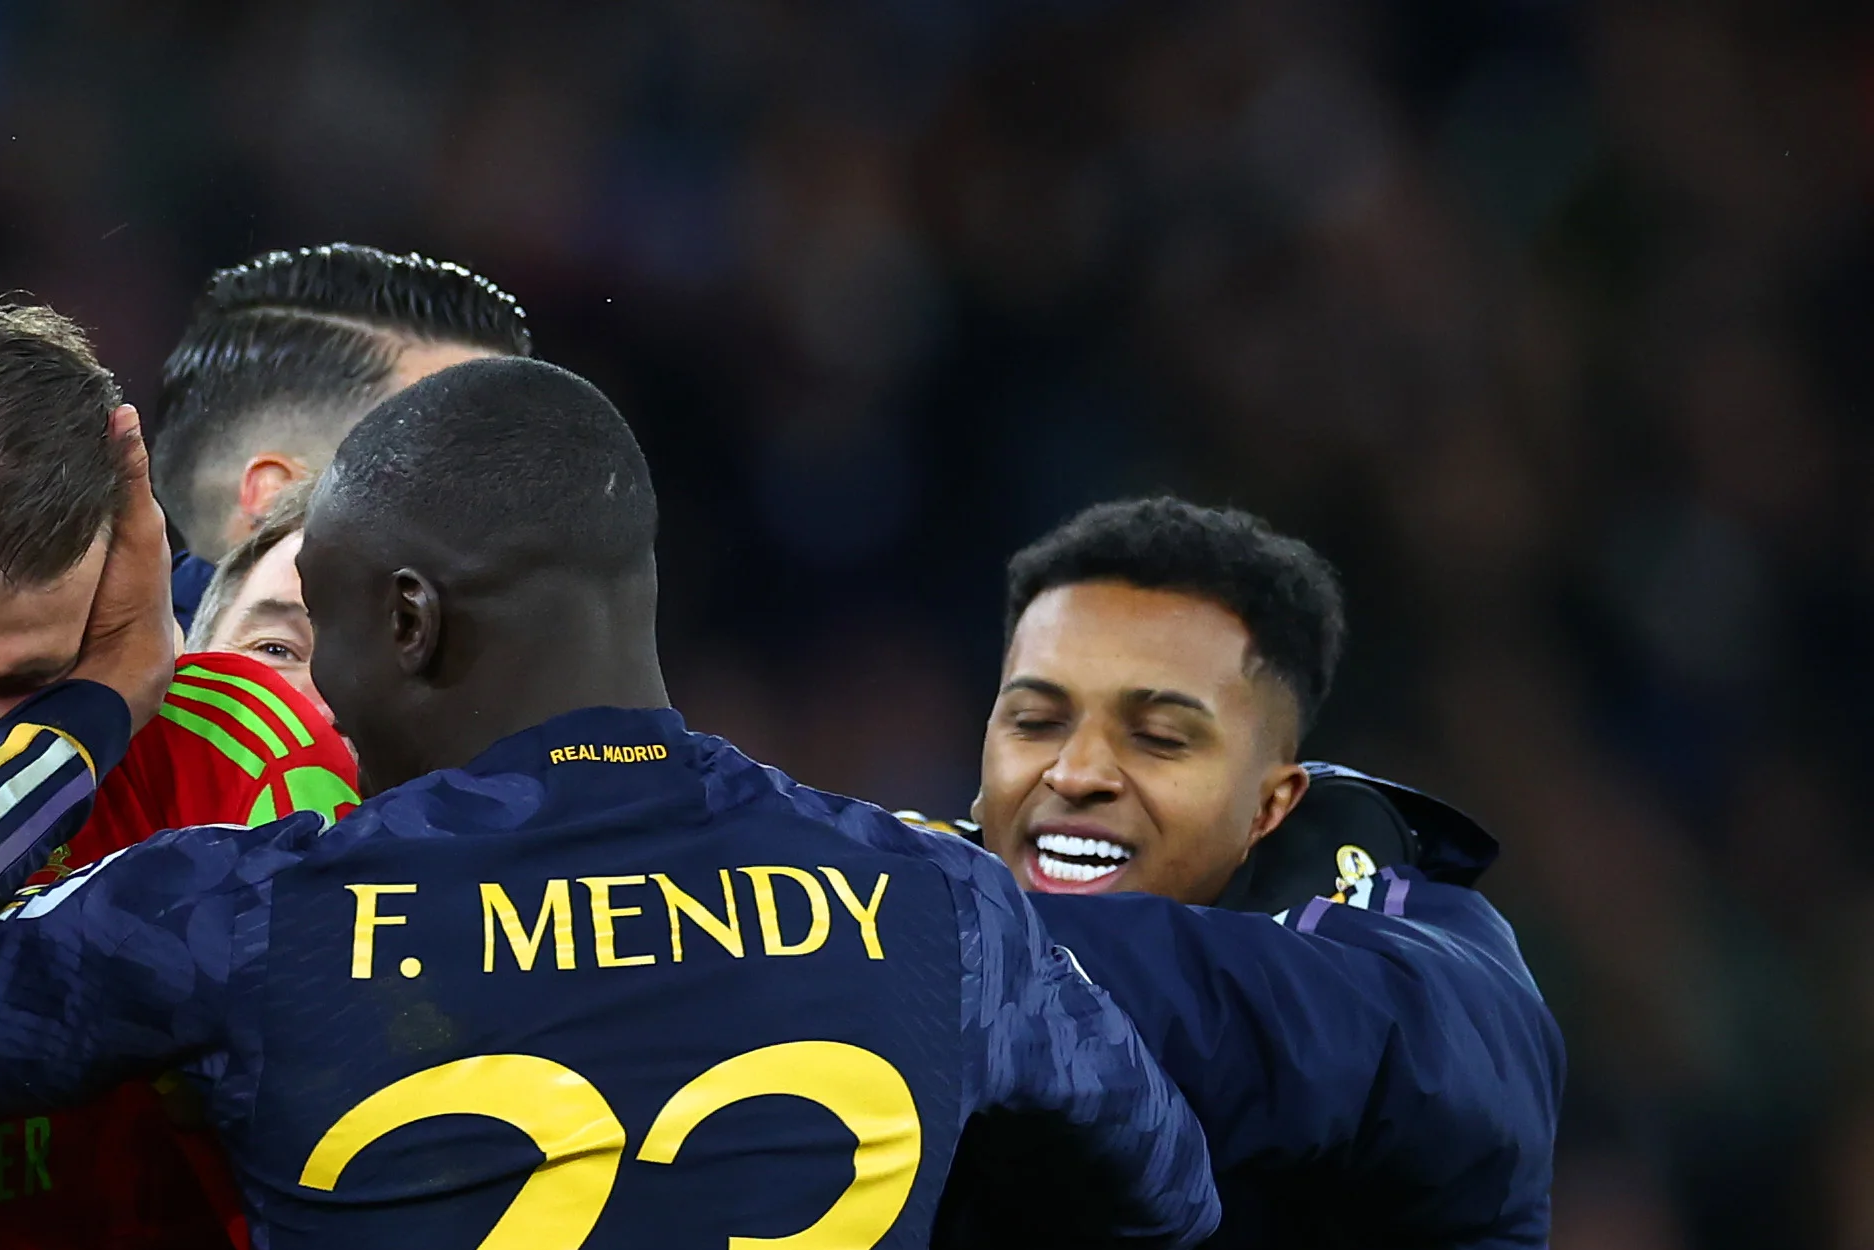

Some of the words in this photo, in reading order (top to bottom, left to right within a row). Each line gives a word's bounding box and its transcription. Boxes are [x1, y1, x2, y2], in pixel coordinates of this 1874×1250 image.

[549, 744, 601, 765] REAL
[603, 744, 668, 763] MADRID
[345, 883, 424, 979] F.
[479, 865, 890, 973] MENDY
